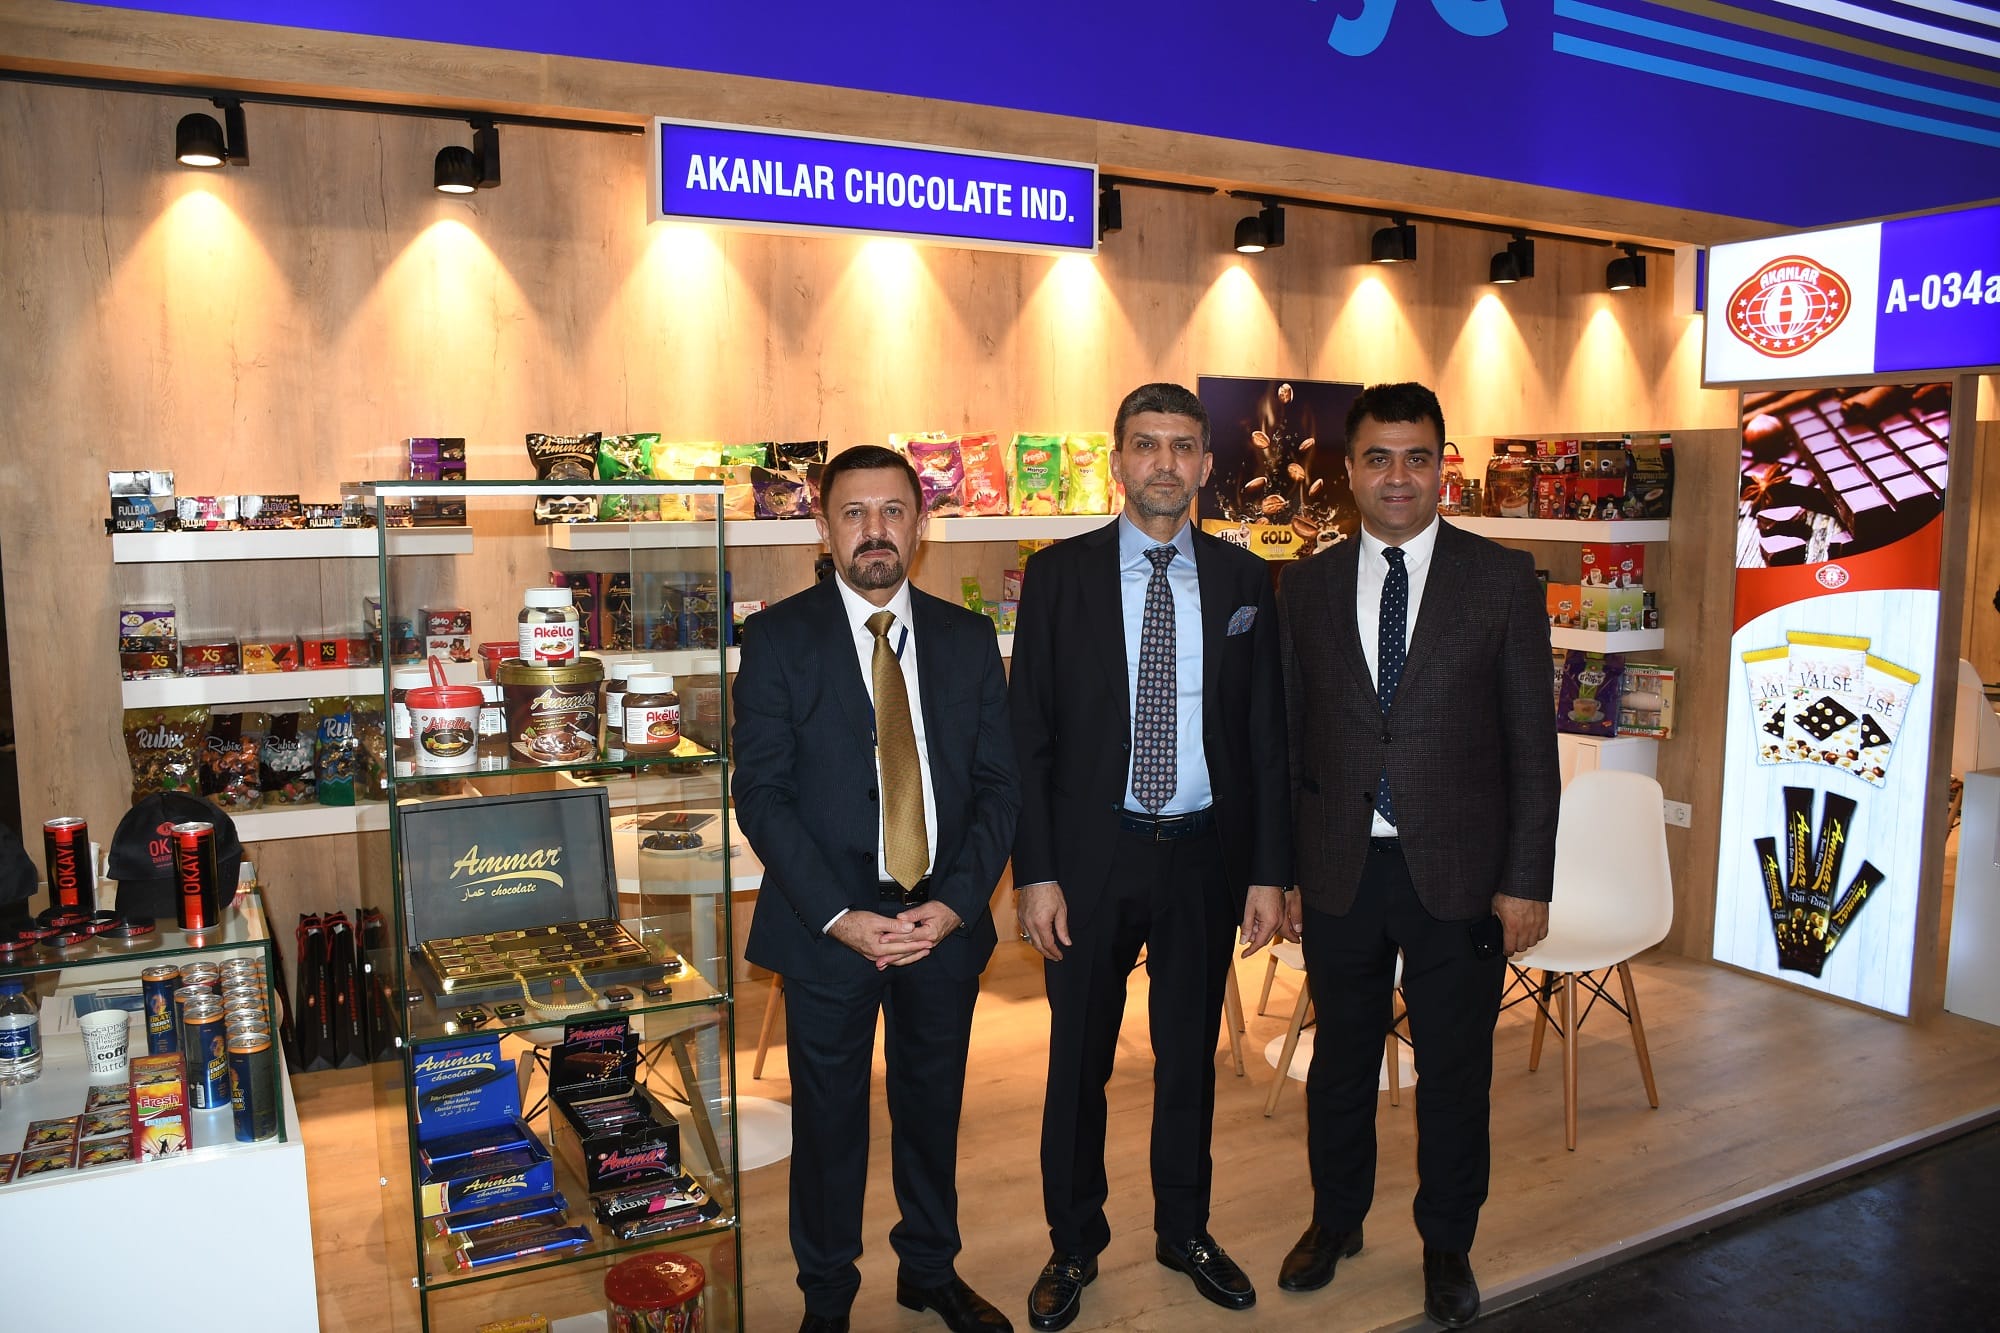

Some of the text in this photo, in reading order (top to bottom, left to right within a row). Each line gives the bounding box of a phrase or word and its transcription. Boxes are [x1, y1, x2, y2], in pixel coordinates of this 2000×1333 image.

[686, 154, 1076, 224] AKANLAR CHOCOLATE IND.
[1760, 266, 1821, 289] AKANLAR
[1885, 270, 2000, 314] A-034a
[536, 438, 593, 456] Ammar
[1023, 450, 1047, 464] Fresh
[118, 505, 151, 516] FULLBAR
[116, 520, 145, 529] FULLBAR
[181, 519, 208, 528] FULLBAR
[309, 518, 335, 527] FULLBAR
[1221, 531, 1238, 542] Hot
[1261, 530, 1293, 545] GOLD
[127, 615, 140, 625] X5
[201, 648, 221, 662] X5
[322, 644, 336, 656] X5
[151, 654, 169, 667] X5
[1800, 669, 1853, 693] VALSE
[1761, 682, 1785, 698] VAL
[530, 689, 596, 711] Ammar
[1865, 694, 1896, 718] LSE
[135, 725, 186, 749] Rubix
[205, 735, 243, 753] Rubix
[263, 735, 299, 752] Rubix
[149, 838, 172, 857] OK
[1796, 811, 1811, 888] Ammar
[1821, 818, 1844, 893] Ammar
[449, 844, 562, 880] Ammar
[490, 882, 537, 897] chocolate
[1766, 854, 1783, 908] Ammar
[1838, 880, 1868, 925] Ammar
[86, 924, 104, 934] OAY
[128, 926, 145, 936] OKAY
[150, 1012, 170, 1023] OKAY
[413, 1051, 494, 1074] Ammar
[431, 1068, 477, 1082] chocolate
[140, 1094, 180, 1109] Fresh
[598, 1147, 668, 1174] Ammar
[463, 1173, 527, 1194] Ammar
[477, 1186, 513, 1199] chocolate
[608, 1197, 651, 1217] FULLBAR
